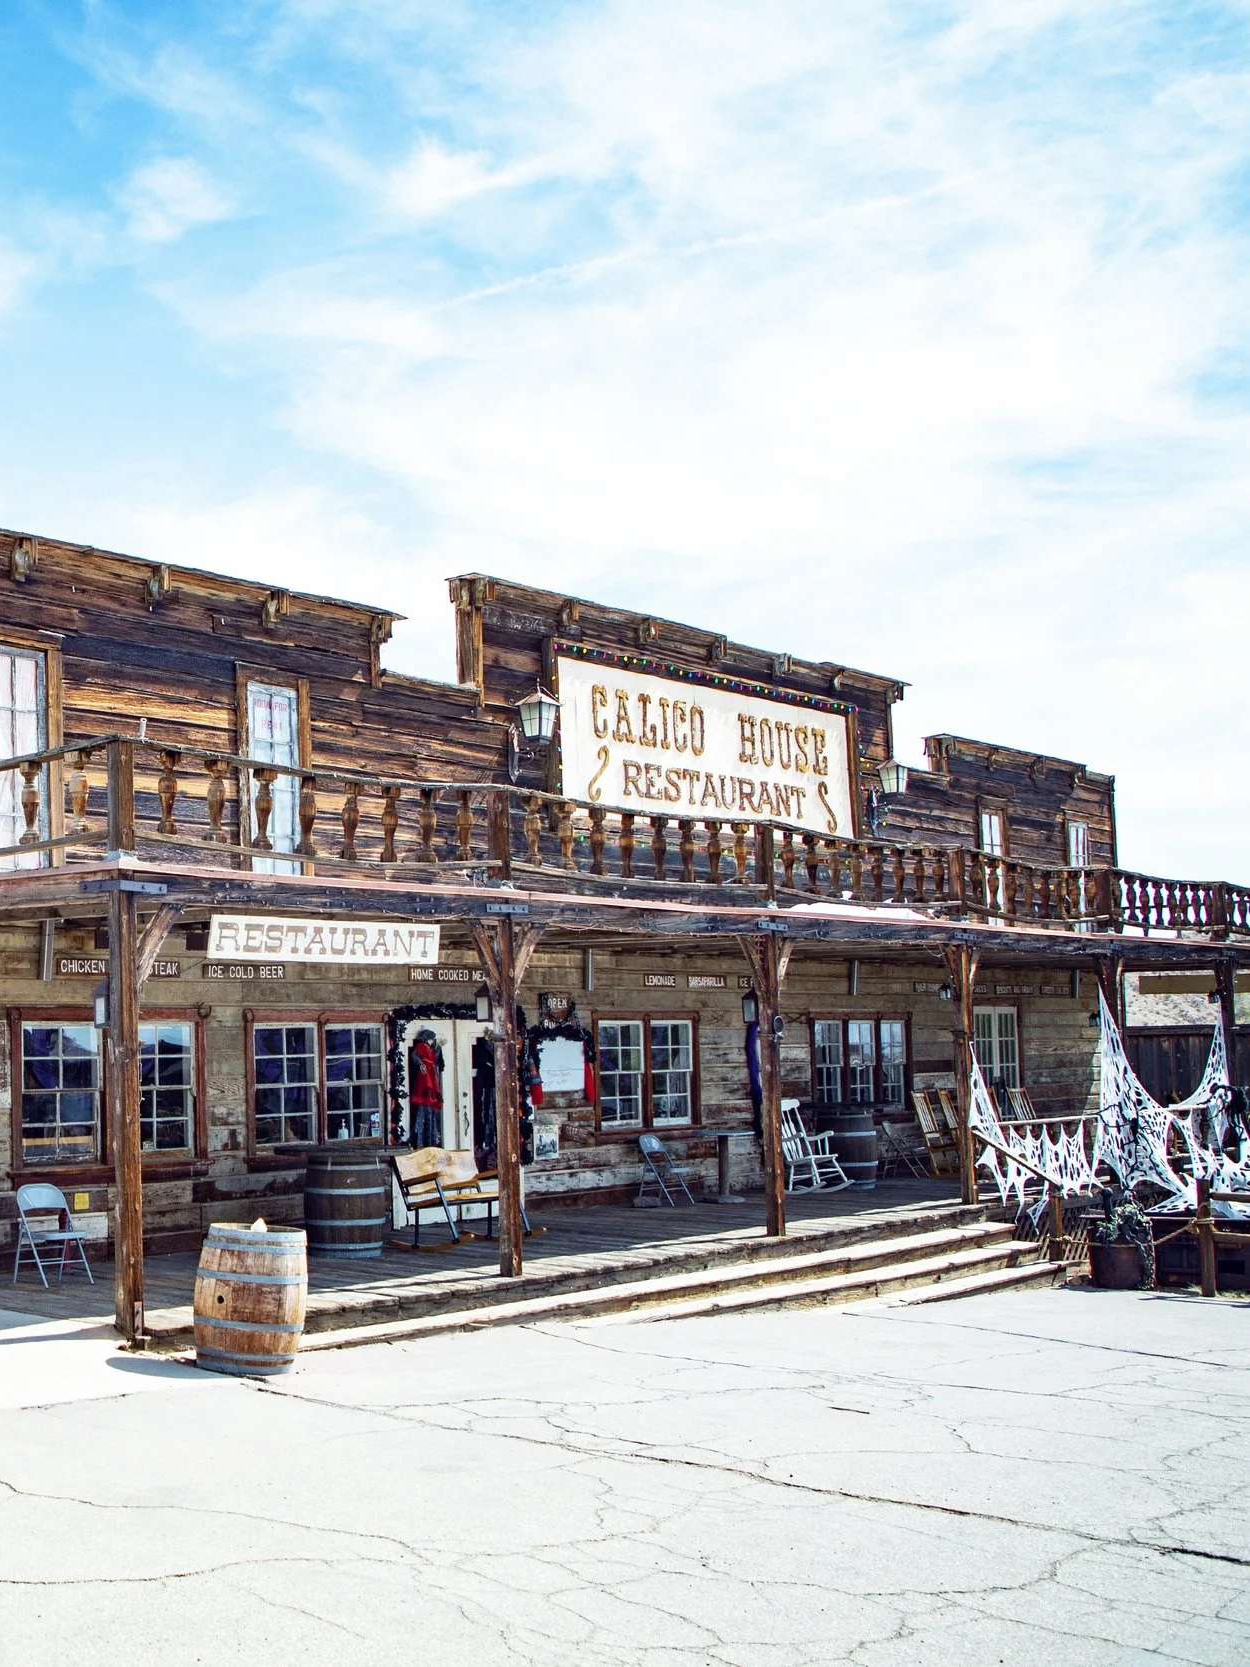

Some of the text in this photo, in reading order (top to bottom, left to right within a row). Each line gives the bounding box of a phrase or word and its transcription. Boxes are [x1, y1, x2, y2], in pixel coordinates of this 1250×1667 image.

[275, 702, 287, 712] FOR
[262, 720, 283, 730] RENT
[591, 684, 828, 776] CALICO HOUSE
[623, 759, 807, 819] RESTAURANT
[215, 921, 435, 958] RESTAURANT
[60, 960, 106, 974] CHICKEN
[208, 966, 284, 979] ICE COLD BEER
[411, 968, 487, 981] HOME COOKED MEA
[644, 975, 676, 986] LEMONADE
[688, 976, 725, 987] SARSAPARILLA
[739, 978, 749, 987] ICE
[547, 998, 568, 1009] OPEN
